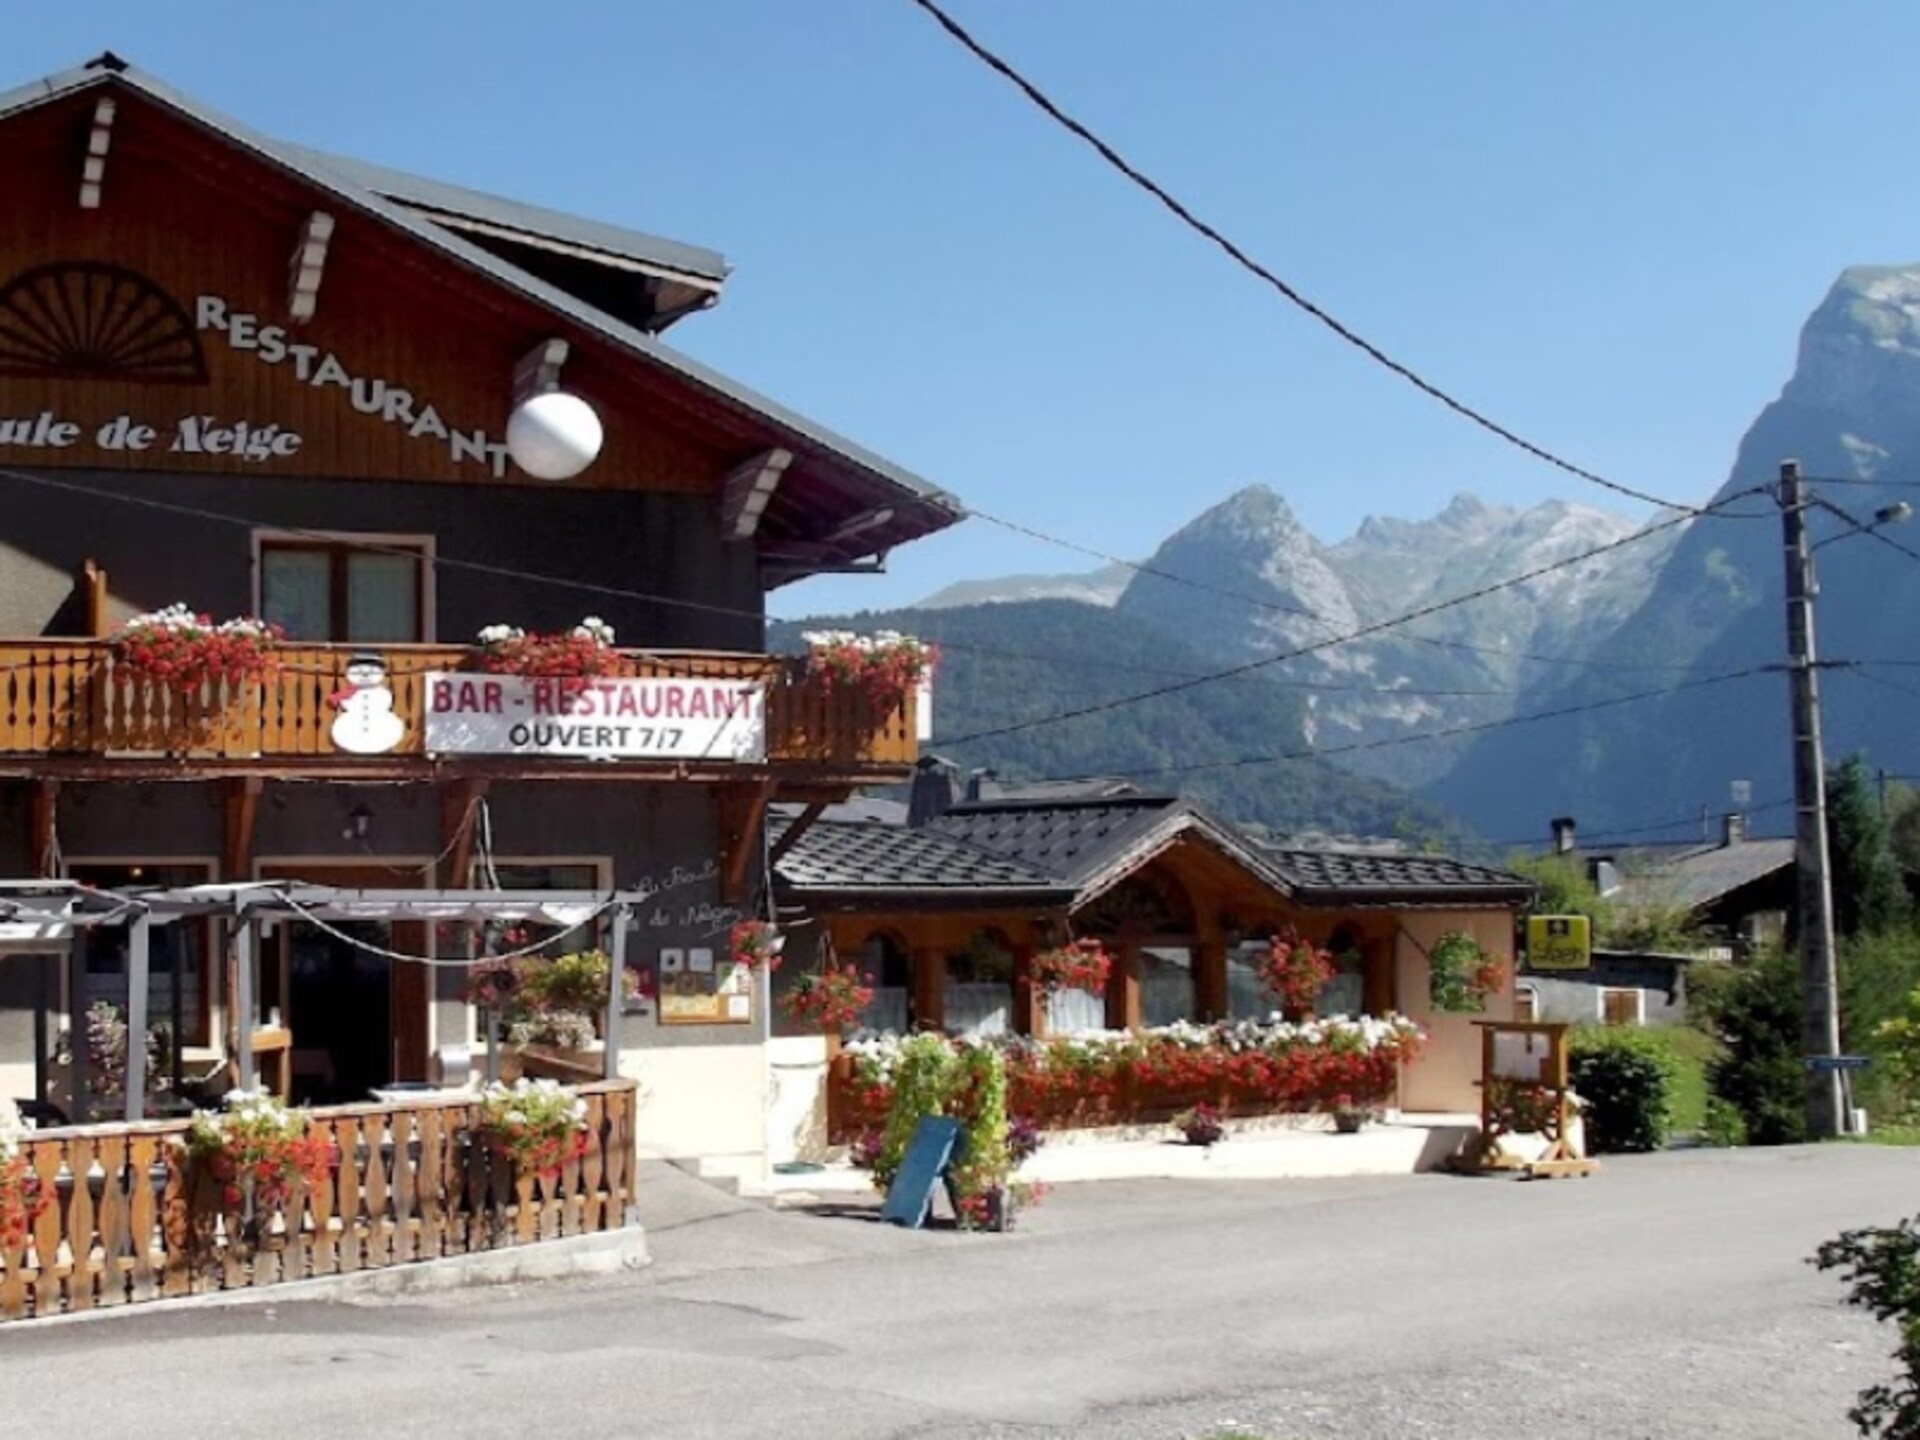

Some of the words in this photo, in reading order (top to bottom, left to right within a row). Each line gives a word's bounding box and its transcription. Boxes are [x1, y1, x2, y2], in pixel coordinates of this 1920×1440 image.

[197, 295, 508, 478] RESTAURANT
[96, 416, 157, 450] de
[170, 415, 303, 462] Neige
[432, 681, 503, 713] BAR
[533, 682, 755, 719] RESTAURANT
[509, 724, 631, 747] OUVERT
[638, 727, 684, 749] 7/7
